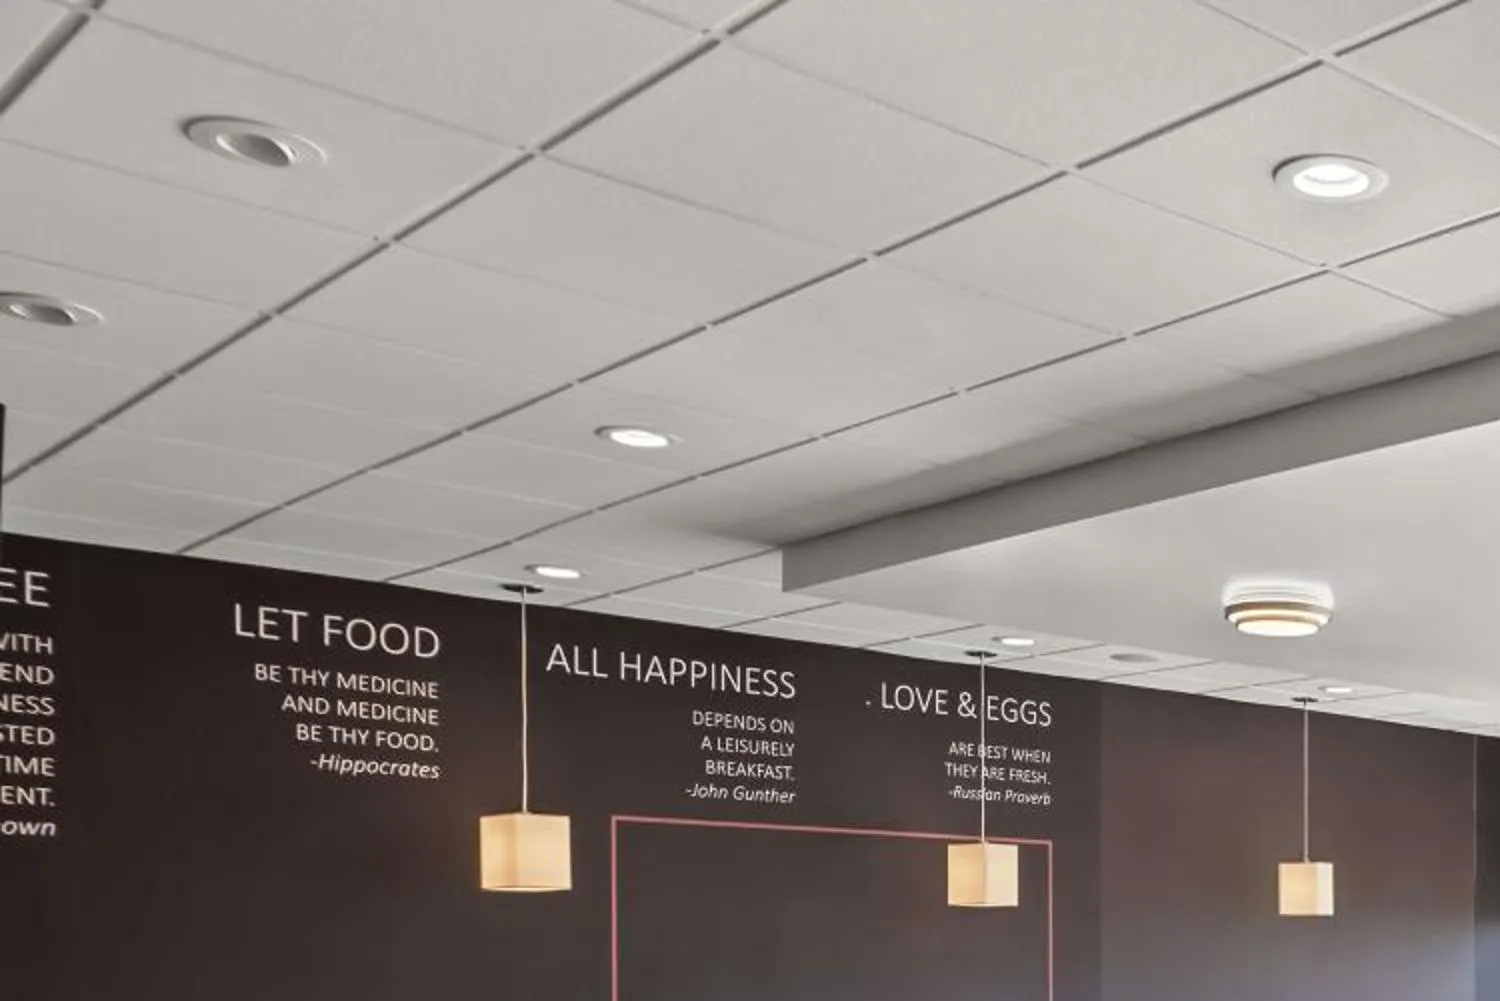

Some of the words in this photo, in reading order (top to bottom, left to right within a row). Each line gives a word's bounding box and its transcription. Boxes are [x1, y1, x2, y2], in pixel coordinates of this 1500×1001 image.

[234, 603, 308, 642] LET
[322, 614, 440, 657] FOOD
[255, 663, 281, 682] BE
[287, 666, 330, 687] THY
[337, 672, 439, 699] MEDICINE
[546, 643, 608, 678] ALL
[619, 651, 796, 699] HAPPINESS
[281, 694, 330, 715] AND
[337, 699, 439, 726] MEDICINE
[881, 682, 949, 715] LOVE
[957, 691, 978, 719] &
[986, 695, 1052, 727] EGGS
[692, 710, 767, 732] DEPENDS
[769, 717, 795, 734] ON
[0, 723, 56, 746] TED
[296, 723, 322, 742] BE
[328, 725, 369, 745] THY
[375, 731, 439, 752] FOOD.
[701, 735, 713, 751] A
[717, 736, 795, 757] LEISURELY
[948, 742, 975, 757] ARE
[977, 743, 1008, 760] BEST
[1011, 748, 1051, 764] WHEN
[310, 753, 441, 779] -Hippocrates
[705, 759, 795, 781] BREAKFAST.
[944, 762, 979, 779] THEY
[981, 766, 1006, 781] ARE
[1009, 768, 1051, 785] FRESH.
[685, 783, 729, 799] -John
[733, 785, 797, 803] Gunther
[1005, 789, 1051, 805] Proverb
